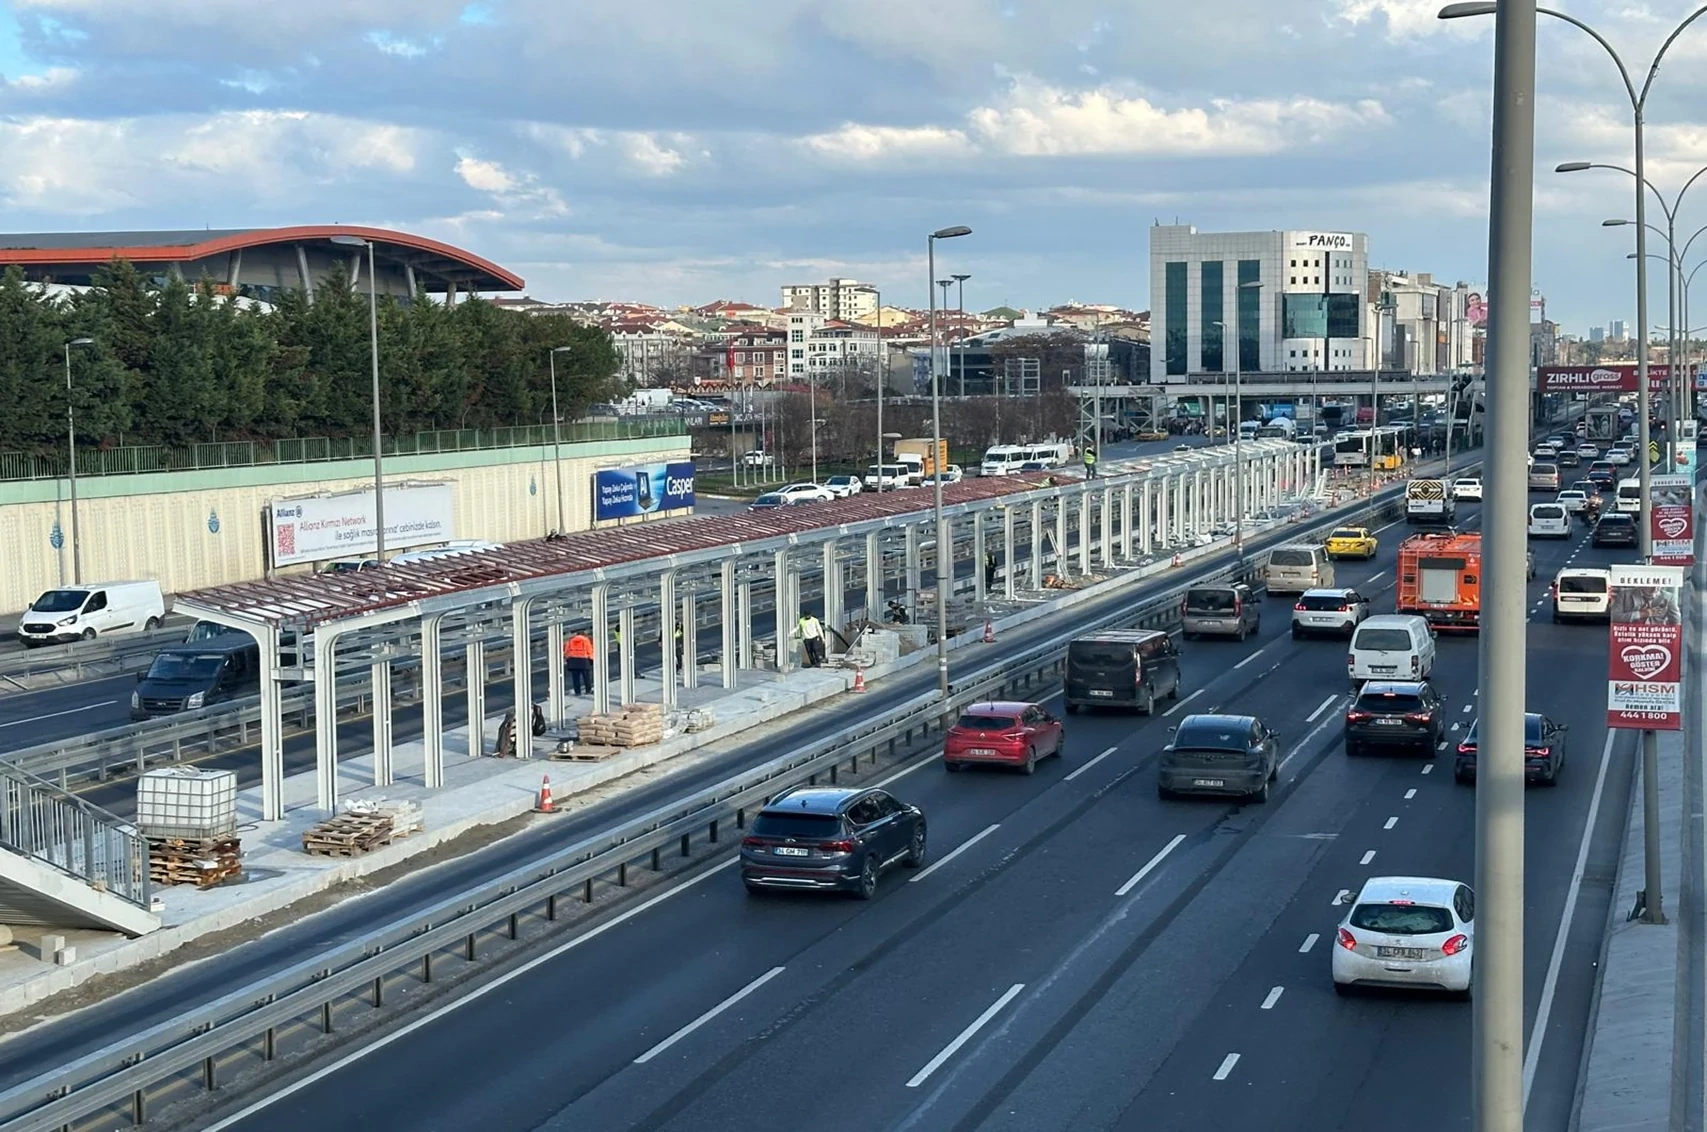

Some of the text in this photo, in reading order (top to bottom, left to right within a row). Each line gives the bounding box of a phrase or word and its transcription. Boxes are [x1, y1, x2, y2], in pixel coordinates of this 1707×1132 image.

[1309, 235, 1345, 249] PANÇO
[1547, 373, 1619, 383] ZIRHLI gross
[666, 476, 694, 500] Casper
[277, 508, 295, 518] Allianz
[300, 520, 320, 531] Allianz
[342, 515, 366, 527] Network
[1620, 577, 1672, 585] BEKLEME!
[1623, 653, 1664, 663] KORKMA!
[1635, 684, 1675, 693] HSM
